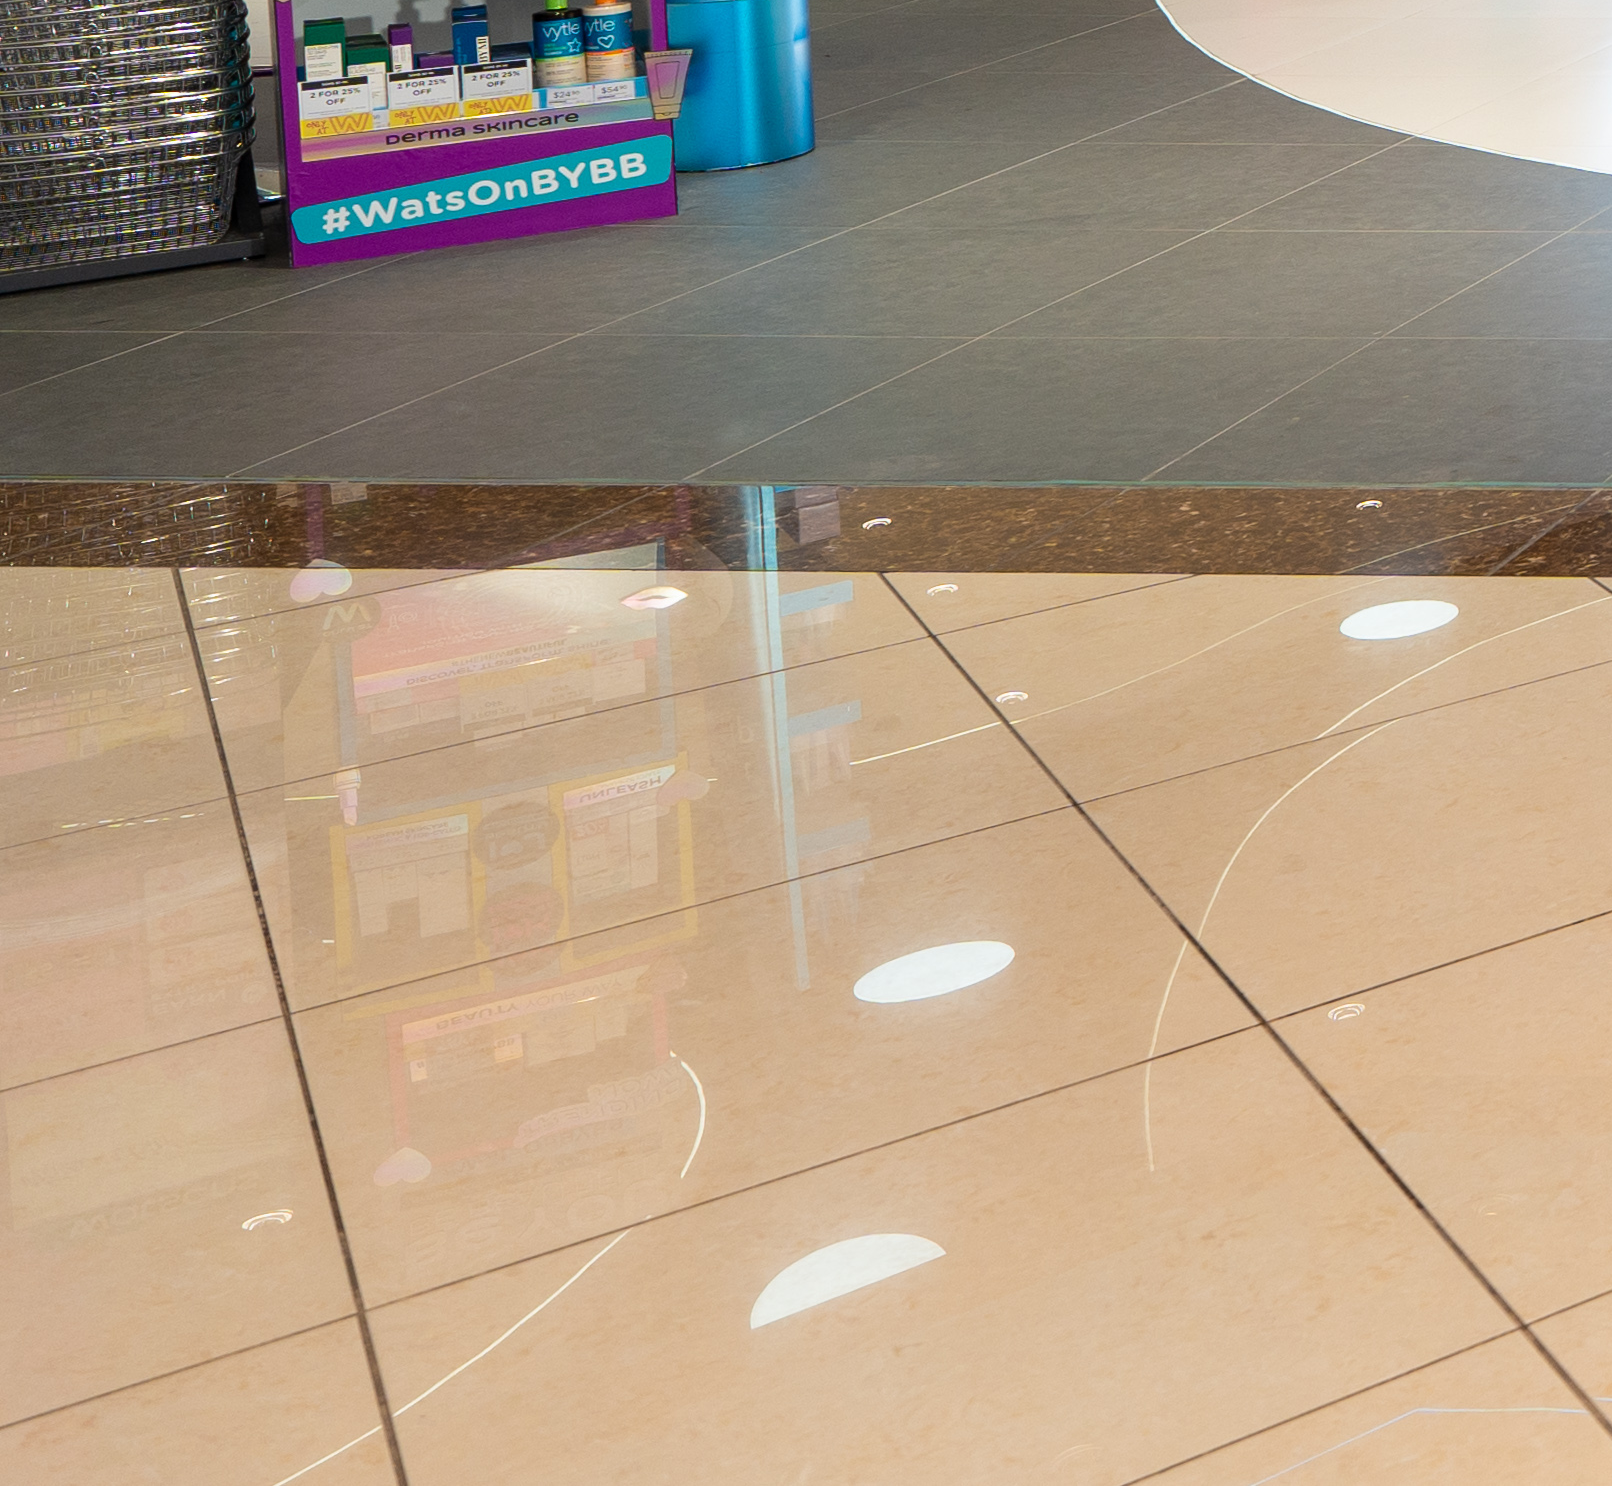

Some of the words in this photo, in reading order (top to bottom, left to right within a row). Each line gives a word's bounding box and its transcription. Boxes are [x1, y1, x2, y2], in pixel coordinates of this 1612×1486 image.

[542, 21, 580, 39] vytle
[412, 87, 432, 96] OFF
[322, 152, 648, 234] #WatsOnBYBB
